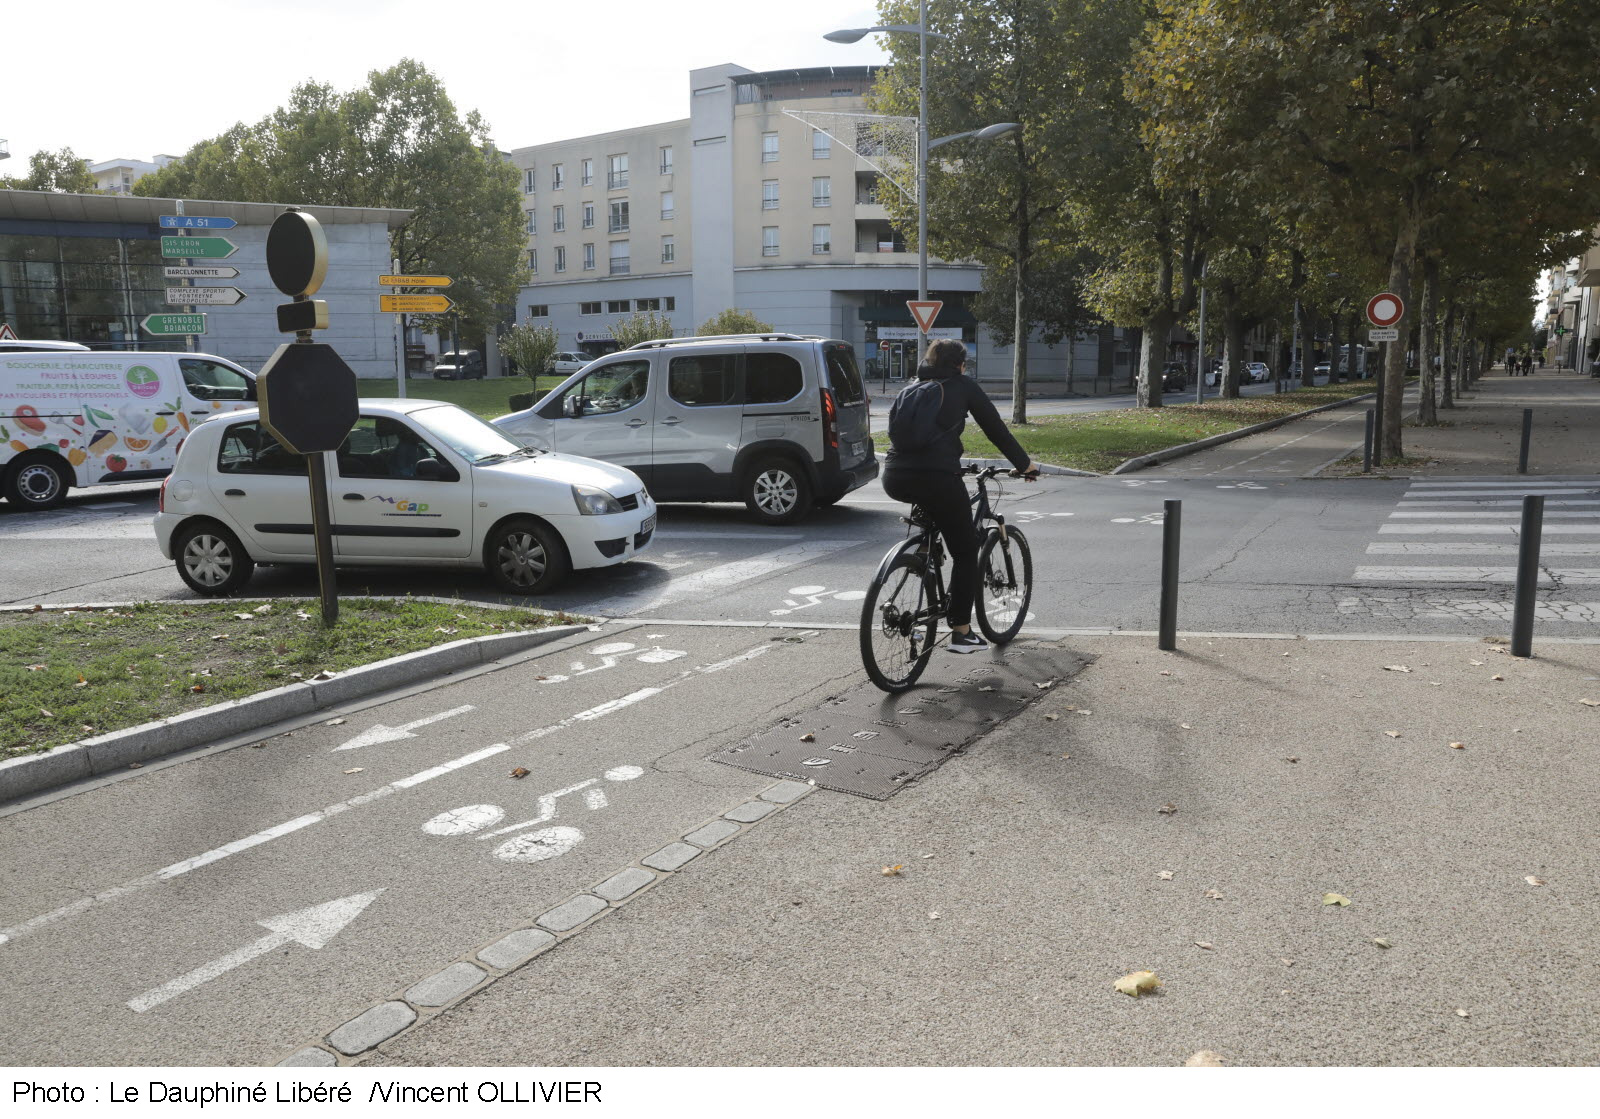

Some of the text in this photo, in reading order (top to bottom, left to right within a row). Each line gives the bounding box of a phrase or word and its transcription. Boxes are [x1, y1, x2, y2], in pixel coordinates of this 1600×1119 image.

[185, 218, 209, 227] A 51
[162, 316, 201, 324] GRENOBLE
[63, 362, 123, 370] CHARCUTERIE
[40, 372, 69, 380] FRUITS
[396, 500, 429, 514] Gap
